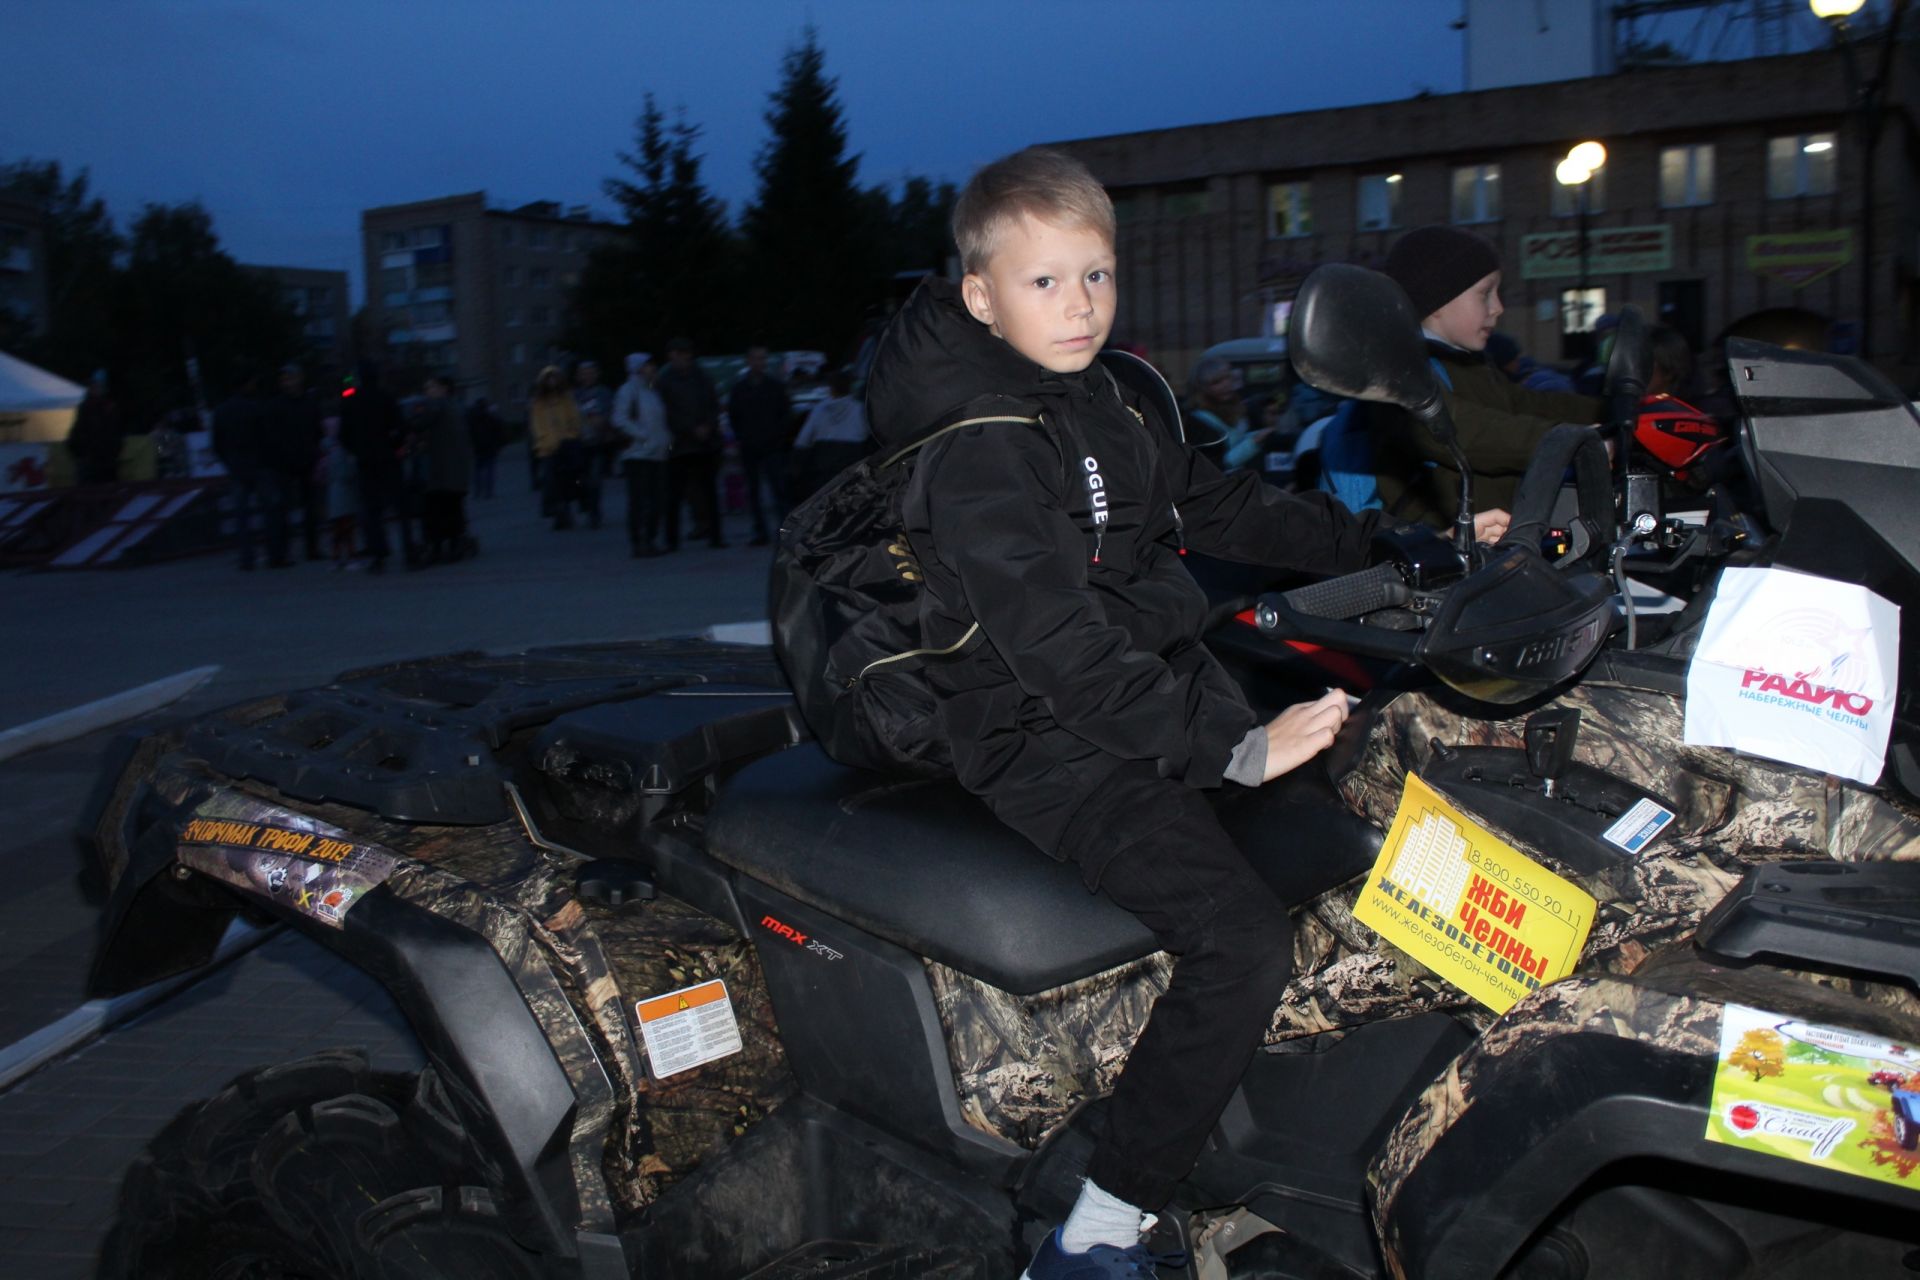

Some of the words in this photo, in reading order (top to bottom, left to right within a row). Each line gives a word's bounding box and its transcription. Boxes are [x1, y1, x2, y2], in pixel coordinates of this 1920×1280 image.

[1738, 690, 1822, 716] НАБЕРЕЖНЫЕ
[1826, 709, 1868, 731] ЧЕЛНЫ
[1741, 668, 1873, 716] РАДИО
[256, 828, 313, 852] ТРОФИ
[309, 838, 353, 863] 2019
[1466, 873, 1527, 929] ЖБИ
[1472, 850, 1480, 863] 8
[1484, 855, 1509, 882] 800
[1513, 876, 1541, 902] 550
[1544, 895, 1562, 914] 90
[1567, 909, 1581, 927] 11
[761, 915, 809, 945] MAX
[807, 939, 844, 960] XT
[1460, 902, 1549, 979] Челны
